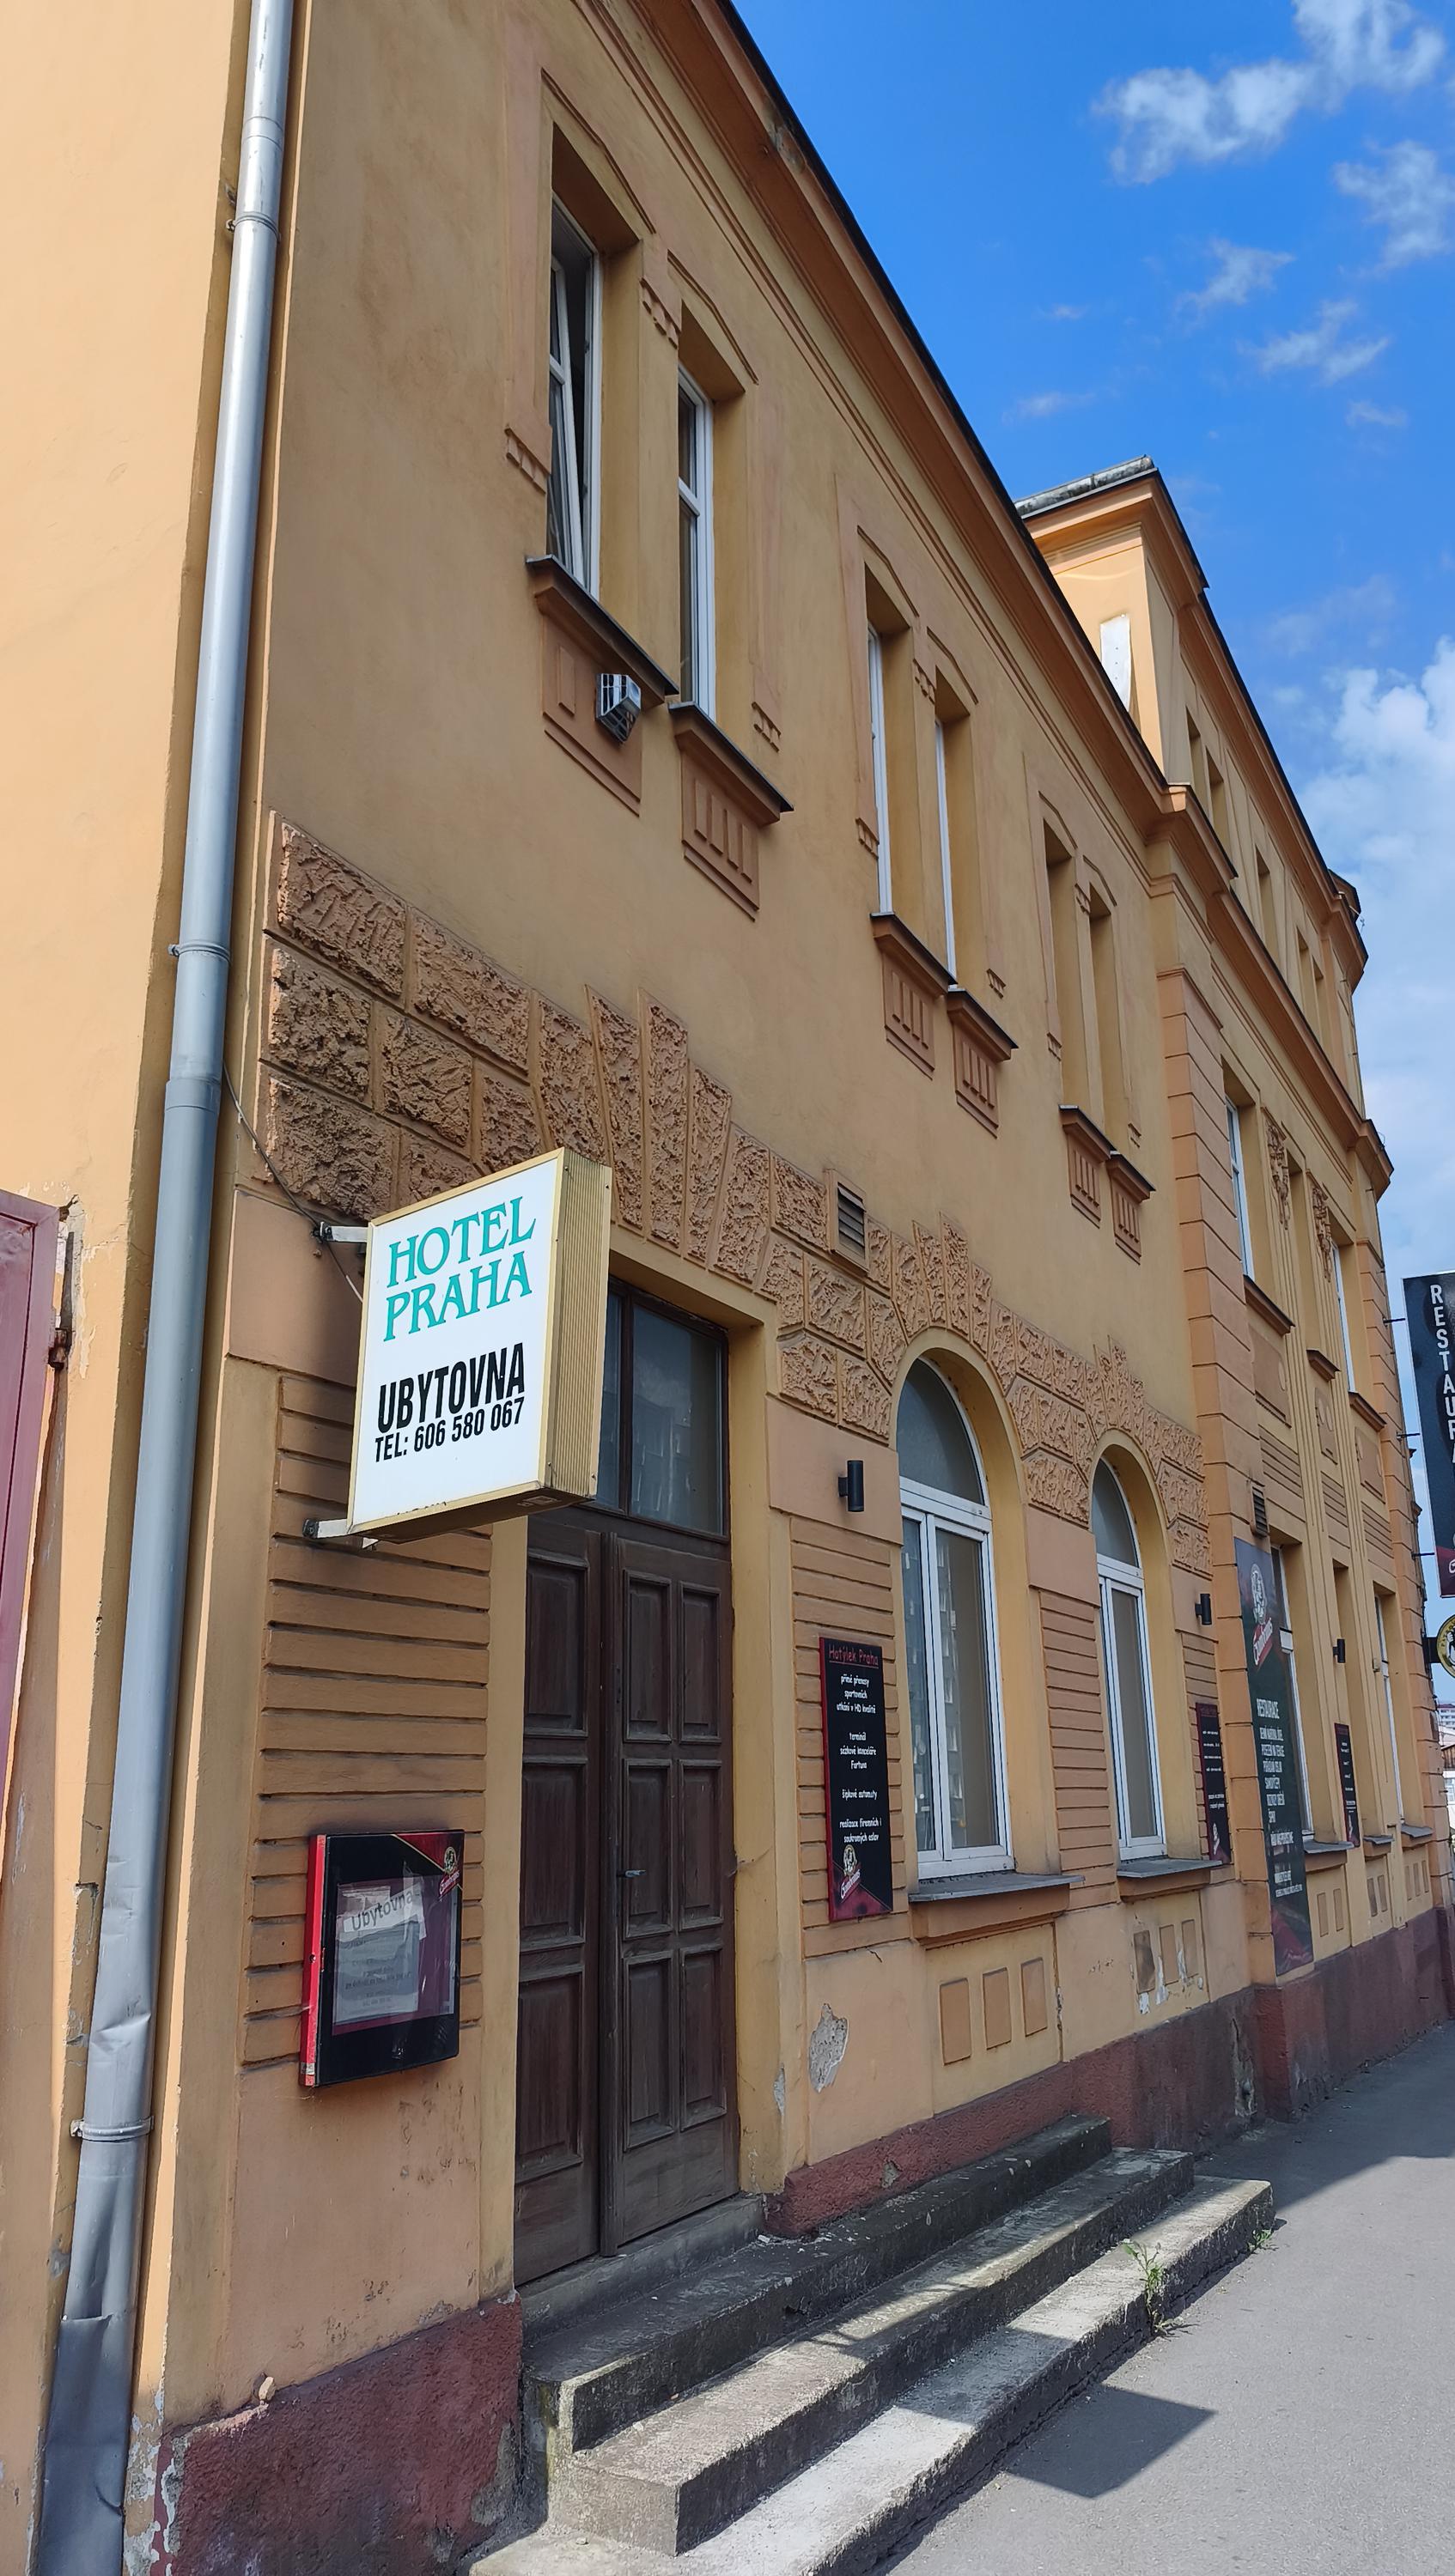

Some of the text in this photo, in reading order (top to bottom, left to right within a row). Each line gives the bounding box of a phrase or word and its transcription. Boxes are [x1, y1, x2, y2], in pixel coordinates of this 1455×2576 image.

[387, 1196, 536, 1288] HOTEL
[383, 1250, 532, 1341] PRAHA
[377, 1342, 525, 1433] UBYTOVNA
[1430, 1284, 1455, 1463] RESTAUR
[375, 1396, 525, 1462] TEL: 606 580 067
[859, 1649, 879, 1666] Praha
[854, 1704, 861, 1713] HD
[850, 1759, 868, 1770] Fortuna
[351, 1891, 413, 1931] Ubytovna
